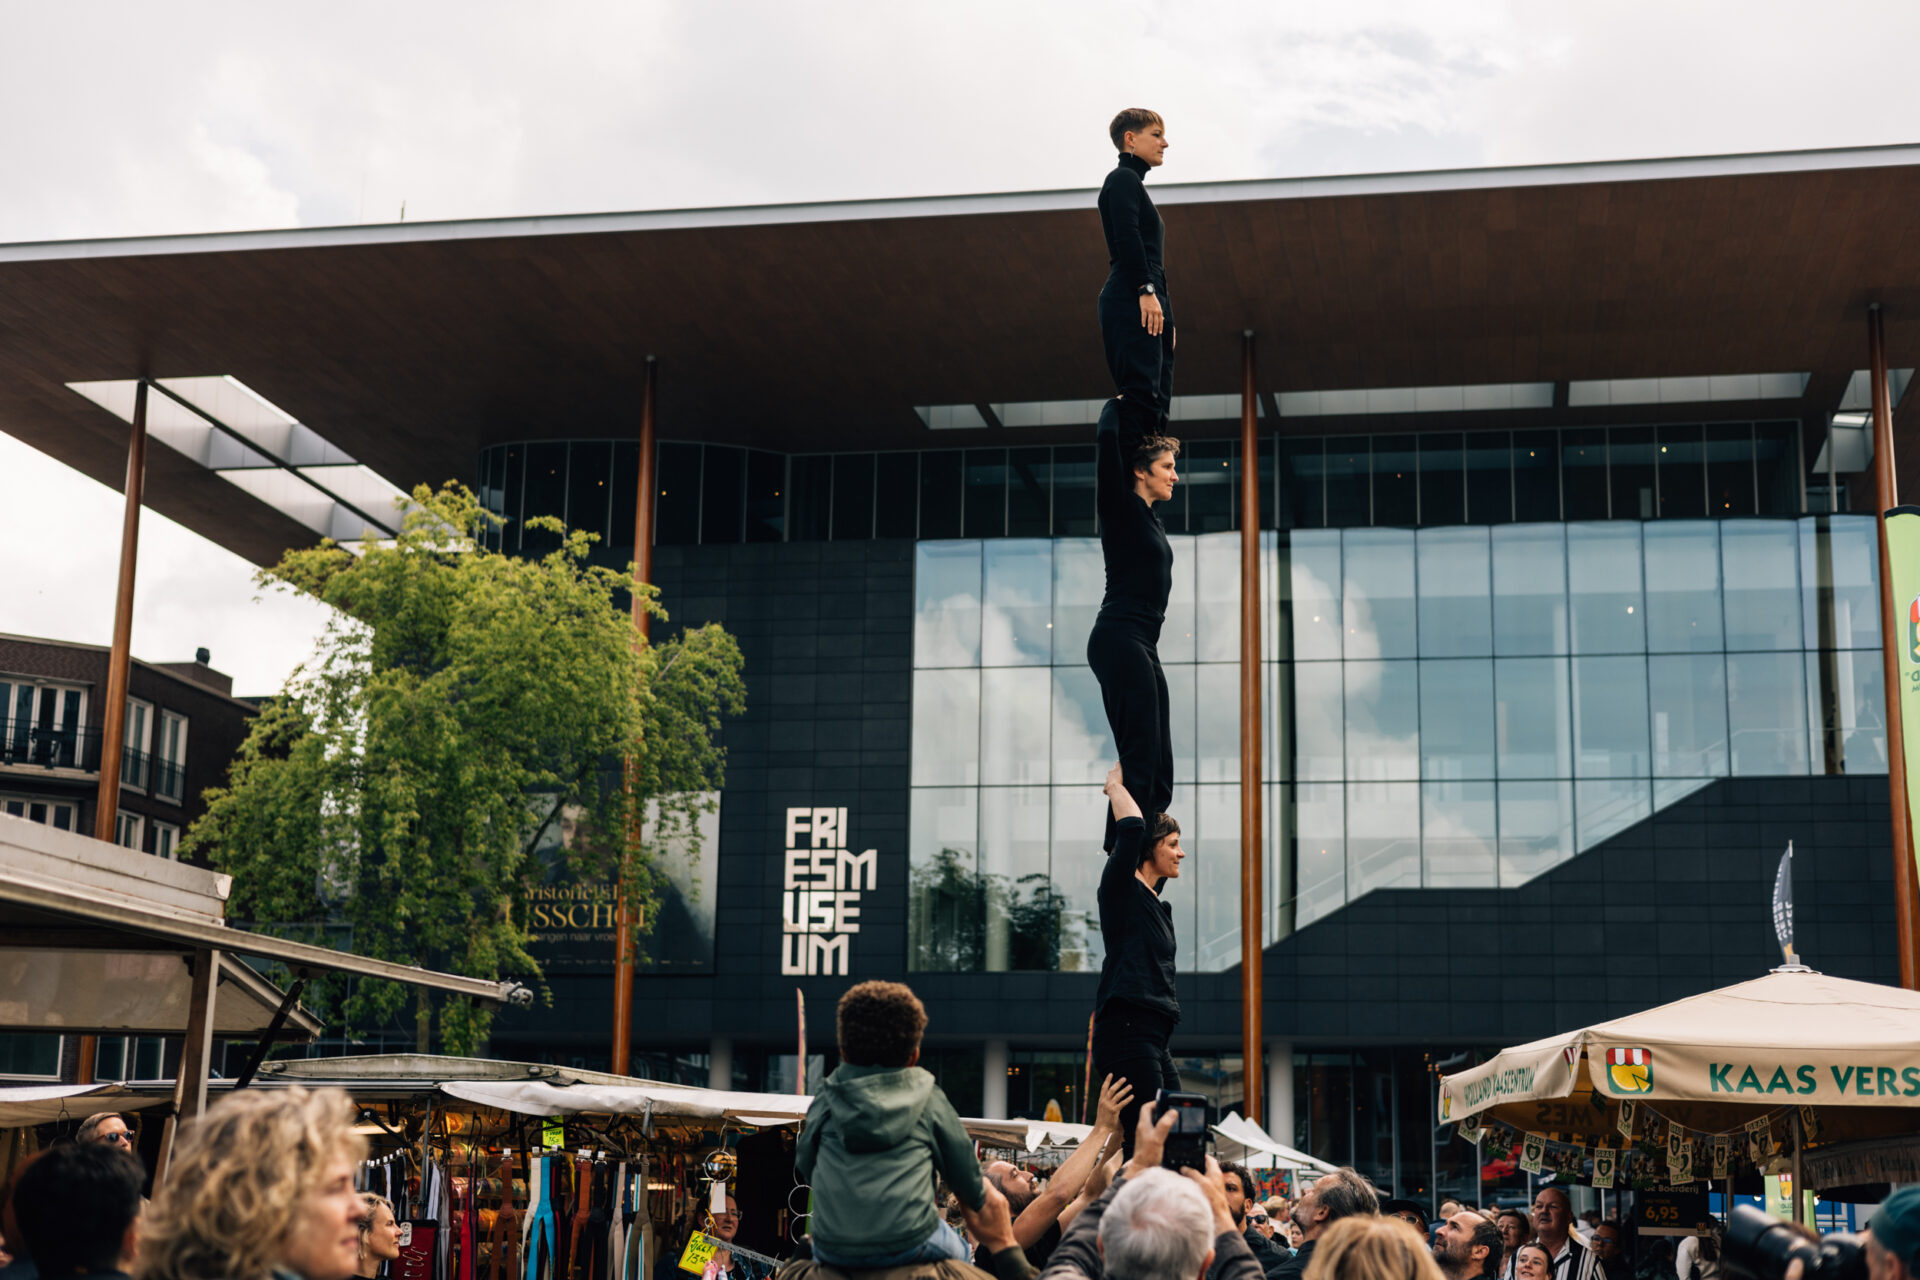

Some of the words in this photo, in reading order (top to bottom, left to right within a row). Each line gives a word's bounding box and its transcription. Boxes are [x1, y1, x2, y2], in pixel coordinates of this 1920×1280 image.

[785, 807, 848, 848] FRI
[784, 849, 877, 890] ESM
[783, 891, 861, 933] USE
[781, 933, 849, 976] UM
[1464, 1076, 1493, 1108] HOLLAND
[1492, 1066, 1536, 1098] KAASCENTRUM
[1709, 1063, 1817, 1095] KAAS
[1830, 1065, 1920, 1097] VERS
[1596, 1150, 1615, 1158] GRAS
[1658, 1183, 1698, 1194] Boerderij
[1645, 1206, 1679, 1223] 6,95
